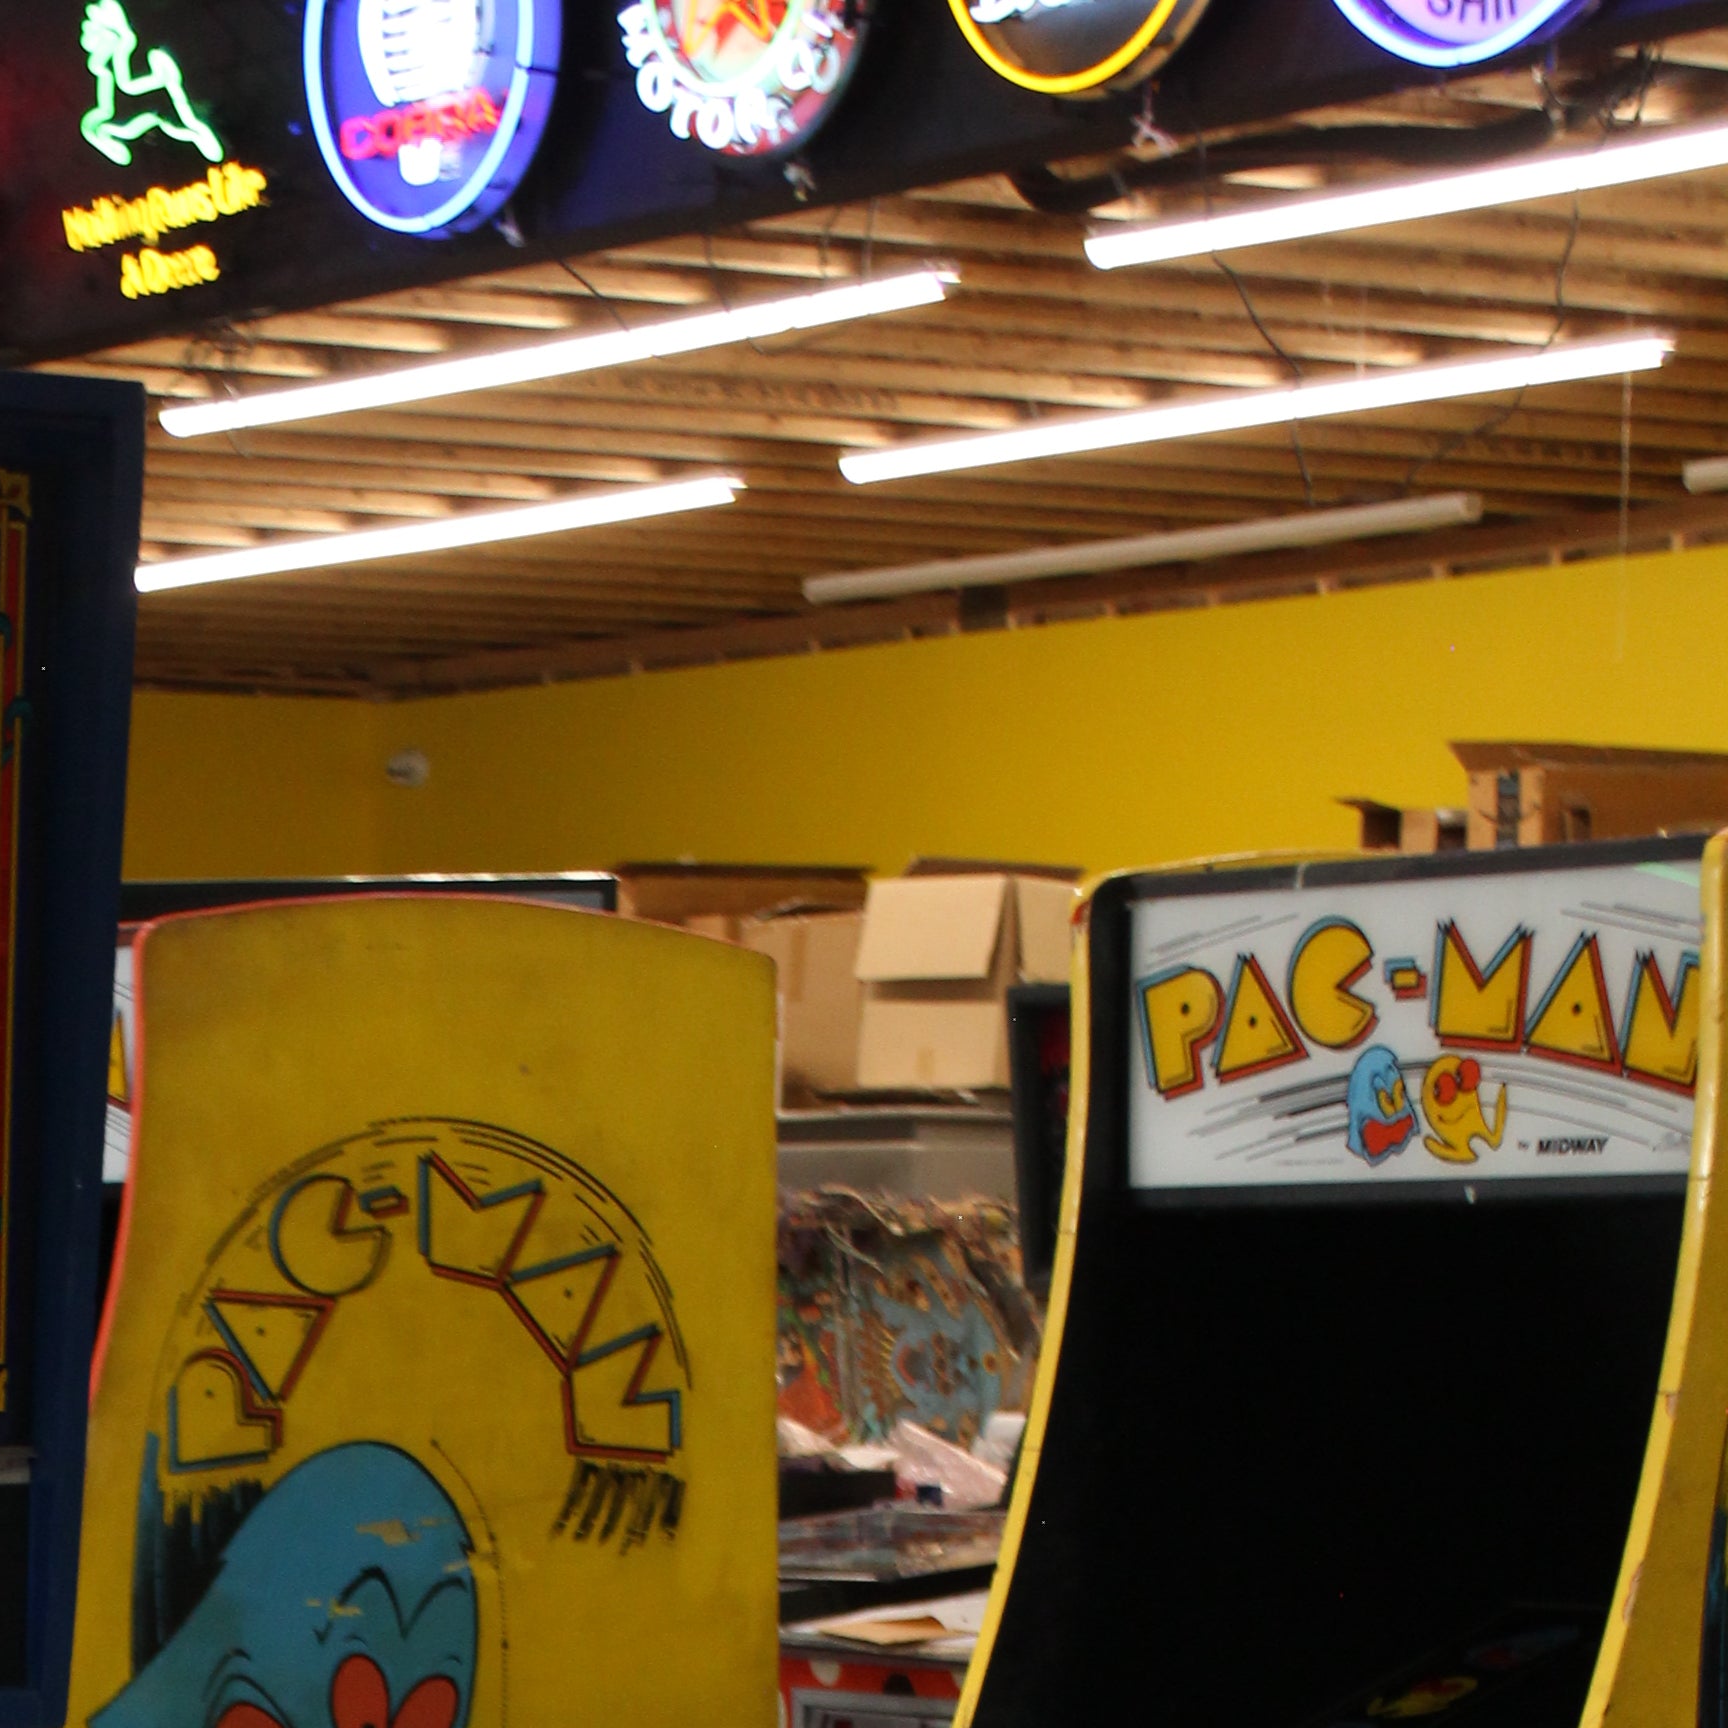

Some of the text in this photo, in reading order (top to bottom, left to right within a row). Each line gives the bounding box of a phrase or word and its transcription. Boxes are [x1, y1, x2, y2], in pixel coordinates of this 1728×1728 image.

[1136, 914, 1701, 1101] PAC-MAN
[1537, 1137, 1611, 1156] MIDWAY
[166, 1150, 684, 1476] PAC-MAN
